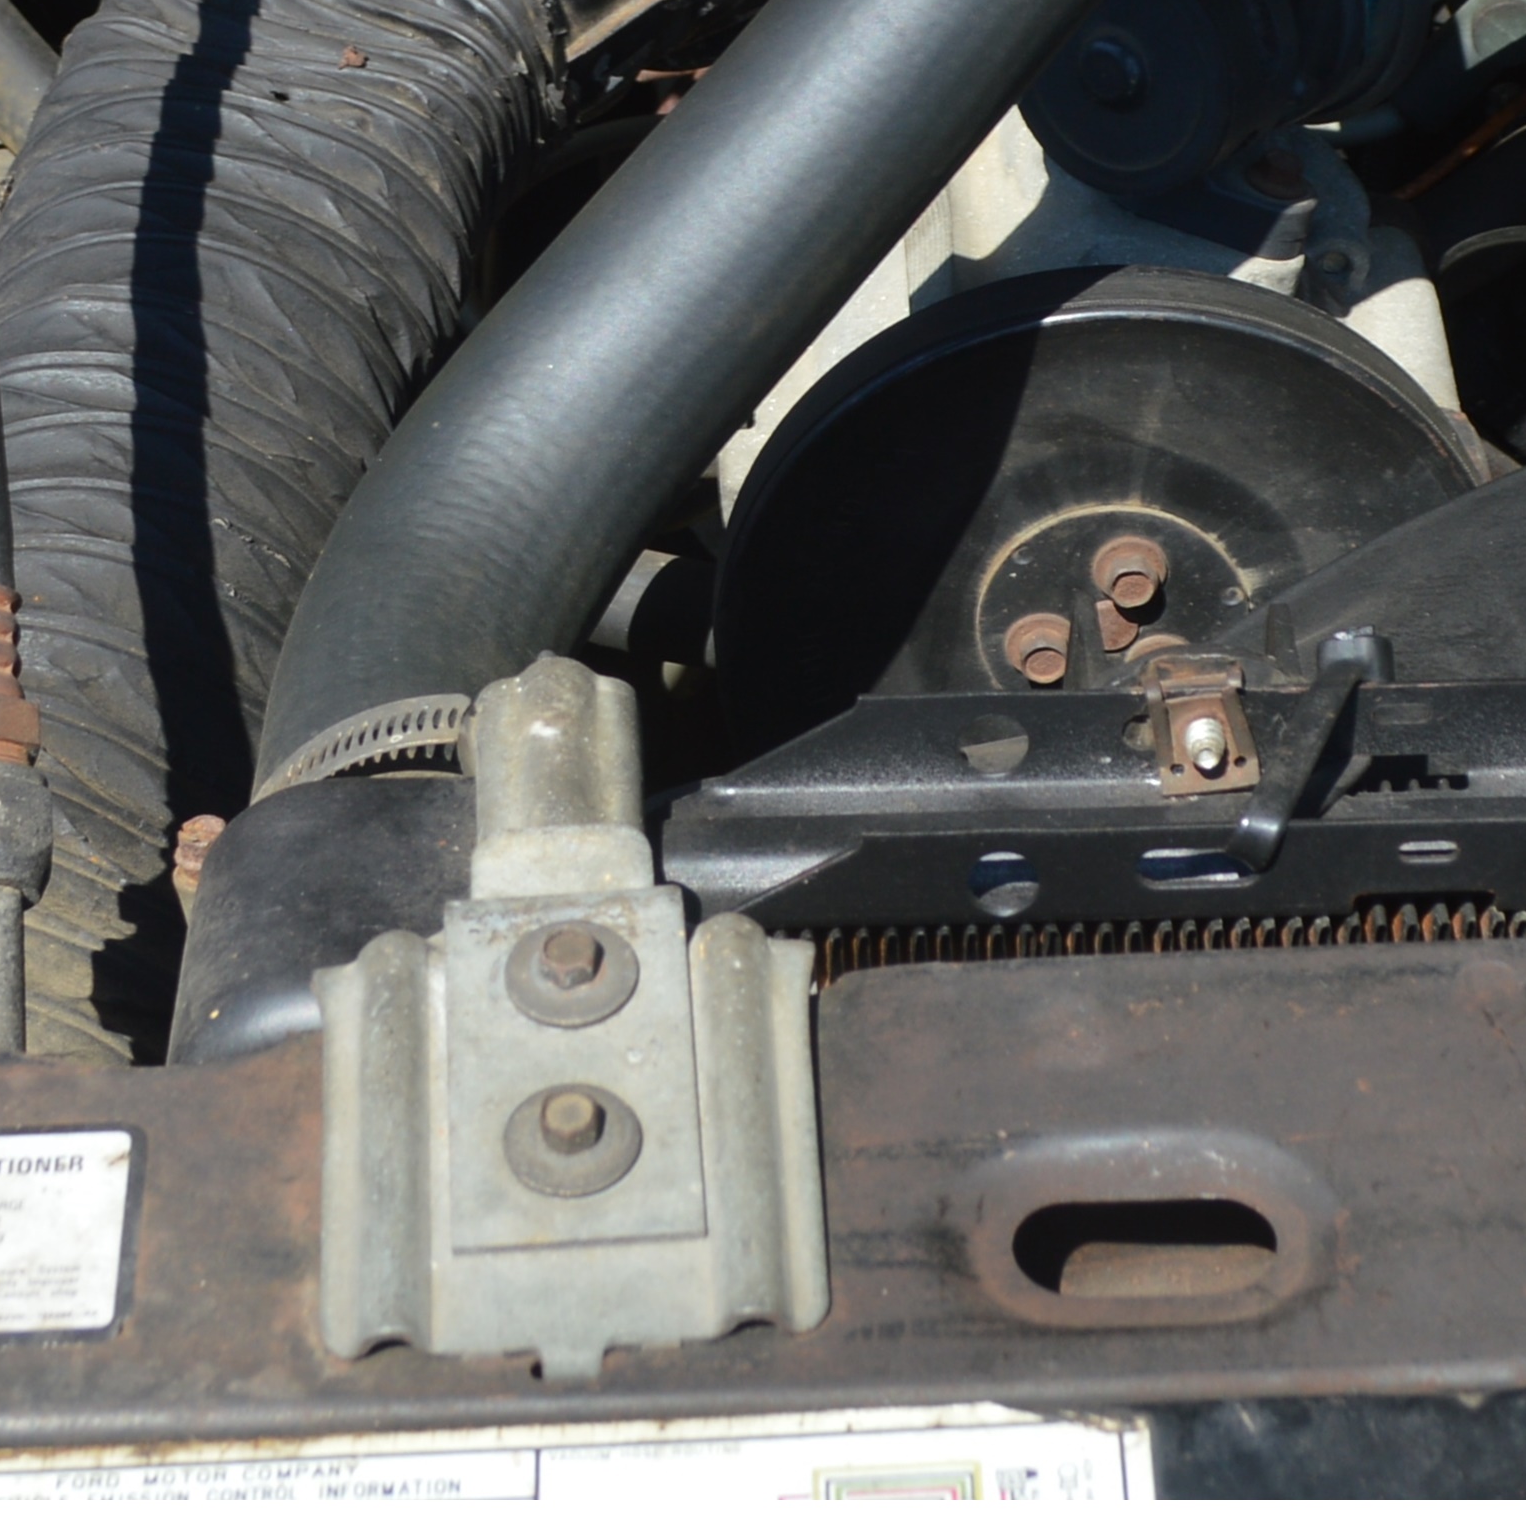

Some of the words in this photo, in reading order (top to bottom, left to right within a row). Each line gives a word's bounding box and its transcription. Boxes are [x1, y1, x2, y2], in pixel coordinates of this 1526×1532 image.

[55, 1469, 120, 1490] FORD
[142, 1466, 228, 1485] MOTOR
[242, 1460, 360, 1482] COMPANY
[205, 1483, 297, 1500] CONTROL
[318, 1477, 462, 1499] INFORMATION
